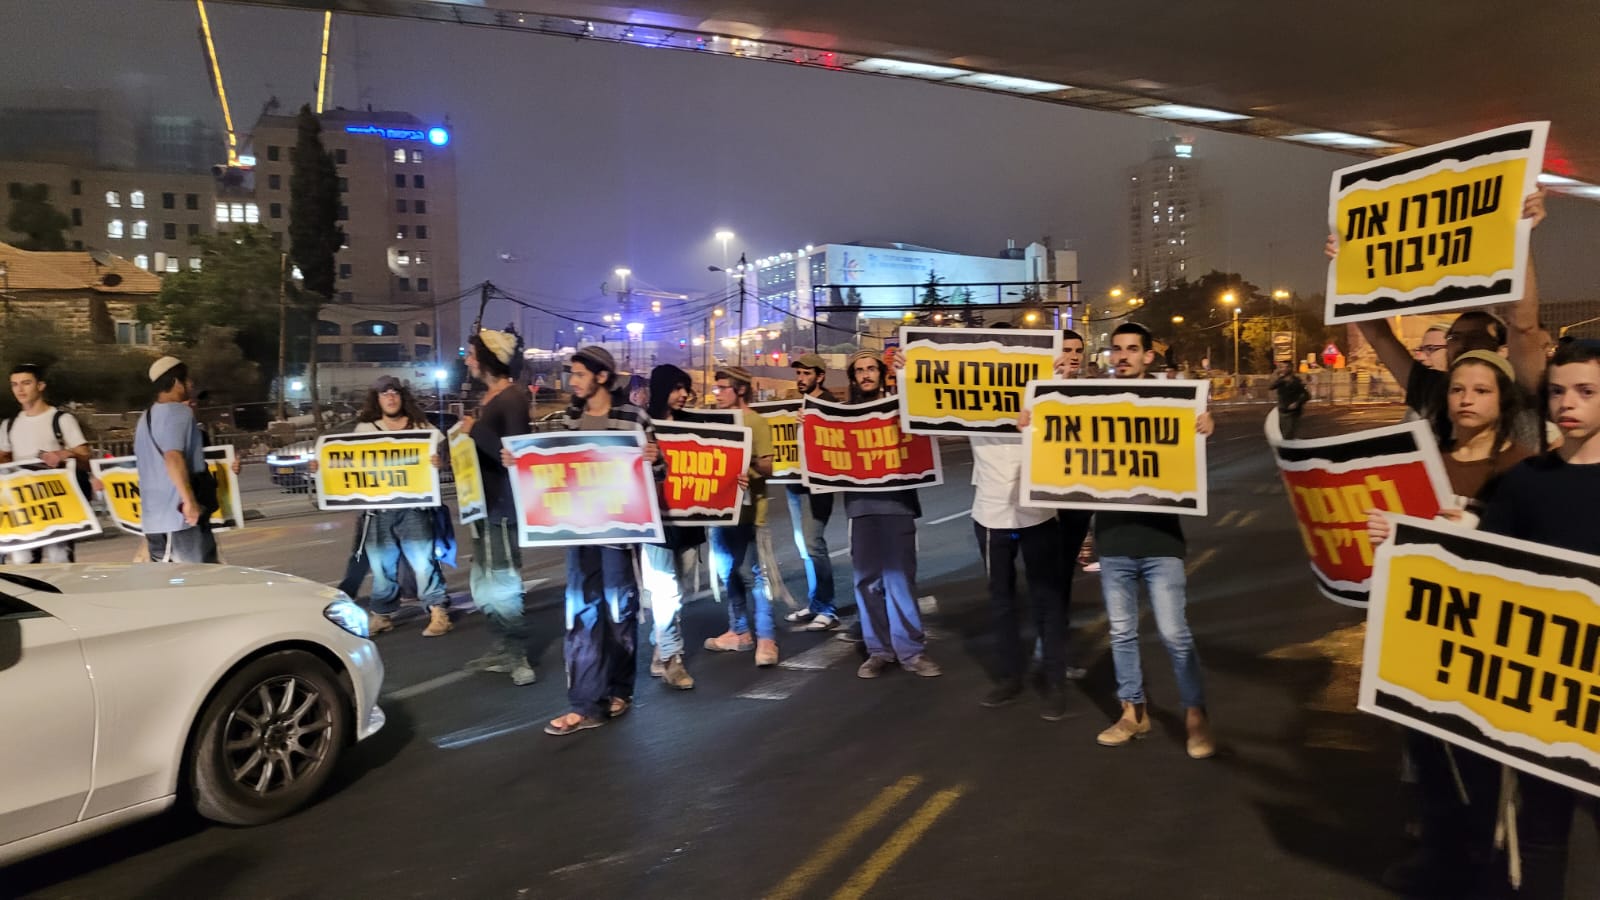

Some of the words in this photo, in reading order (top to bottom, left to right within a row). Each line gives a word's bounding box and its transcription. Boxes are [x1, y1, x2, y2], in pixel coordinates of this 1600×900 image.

[1398, 174, 1503, 232] שחררו
[1345, 200, 1389, 242] את
[1366, 225, 1473, 279] הגיבור!
[915, 358, 950, 385] את
[959, 360, 1038, 387] שחררו
[934, 386, 1020, 413] הגיבור!
[813, 424, 846, 449] את
[1043, 414, 1082, 443] את
[1091, 415, 1180, 446] שחררו
[328, 449, 355, 469] את
[361, 448, 421, 467] שחררו
[666, 447, 728, 477] לסגור
[1063, 447, 1160, 478] הגיבור!
[343, 469, 409, 489] הגיבור!
[1405, 577, 1481, 638] את
[1495, 600, 1600, 674] חררו
[1436, 639, 1600, 736] הגיבור!
